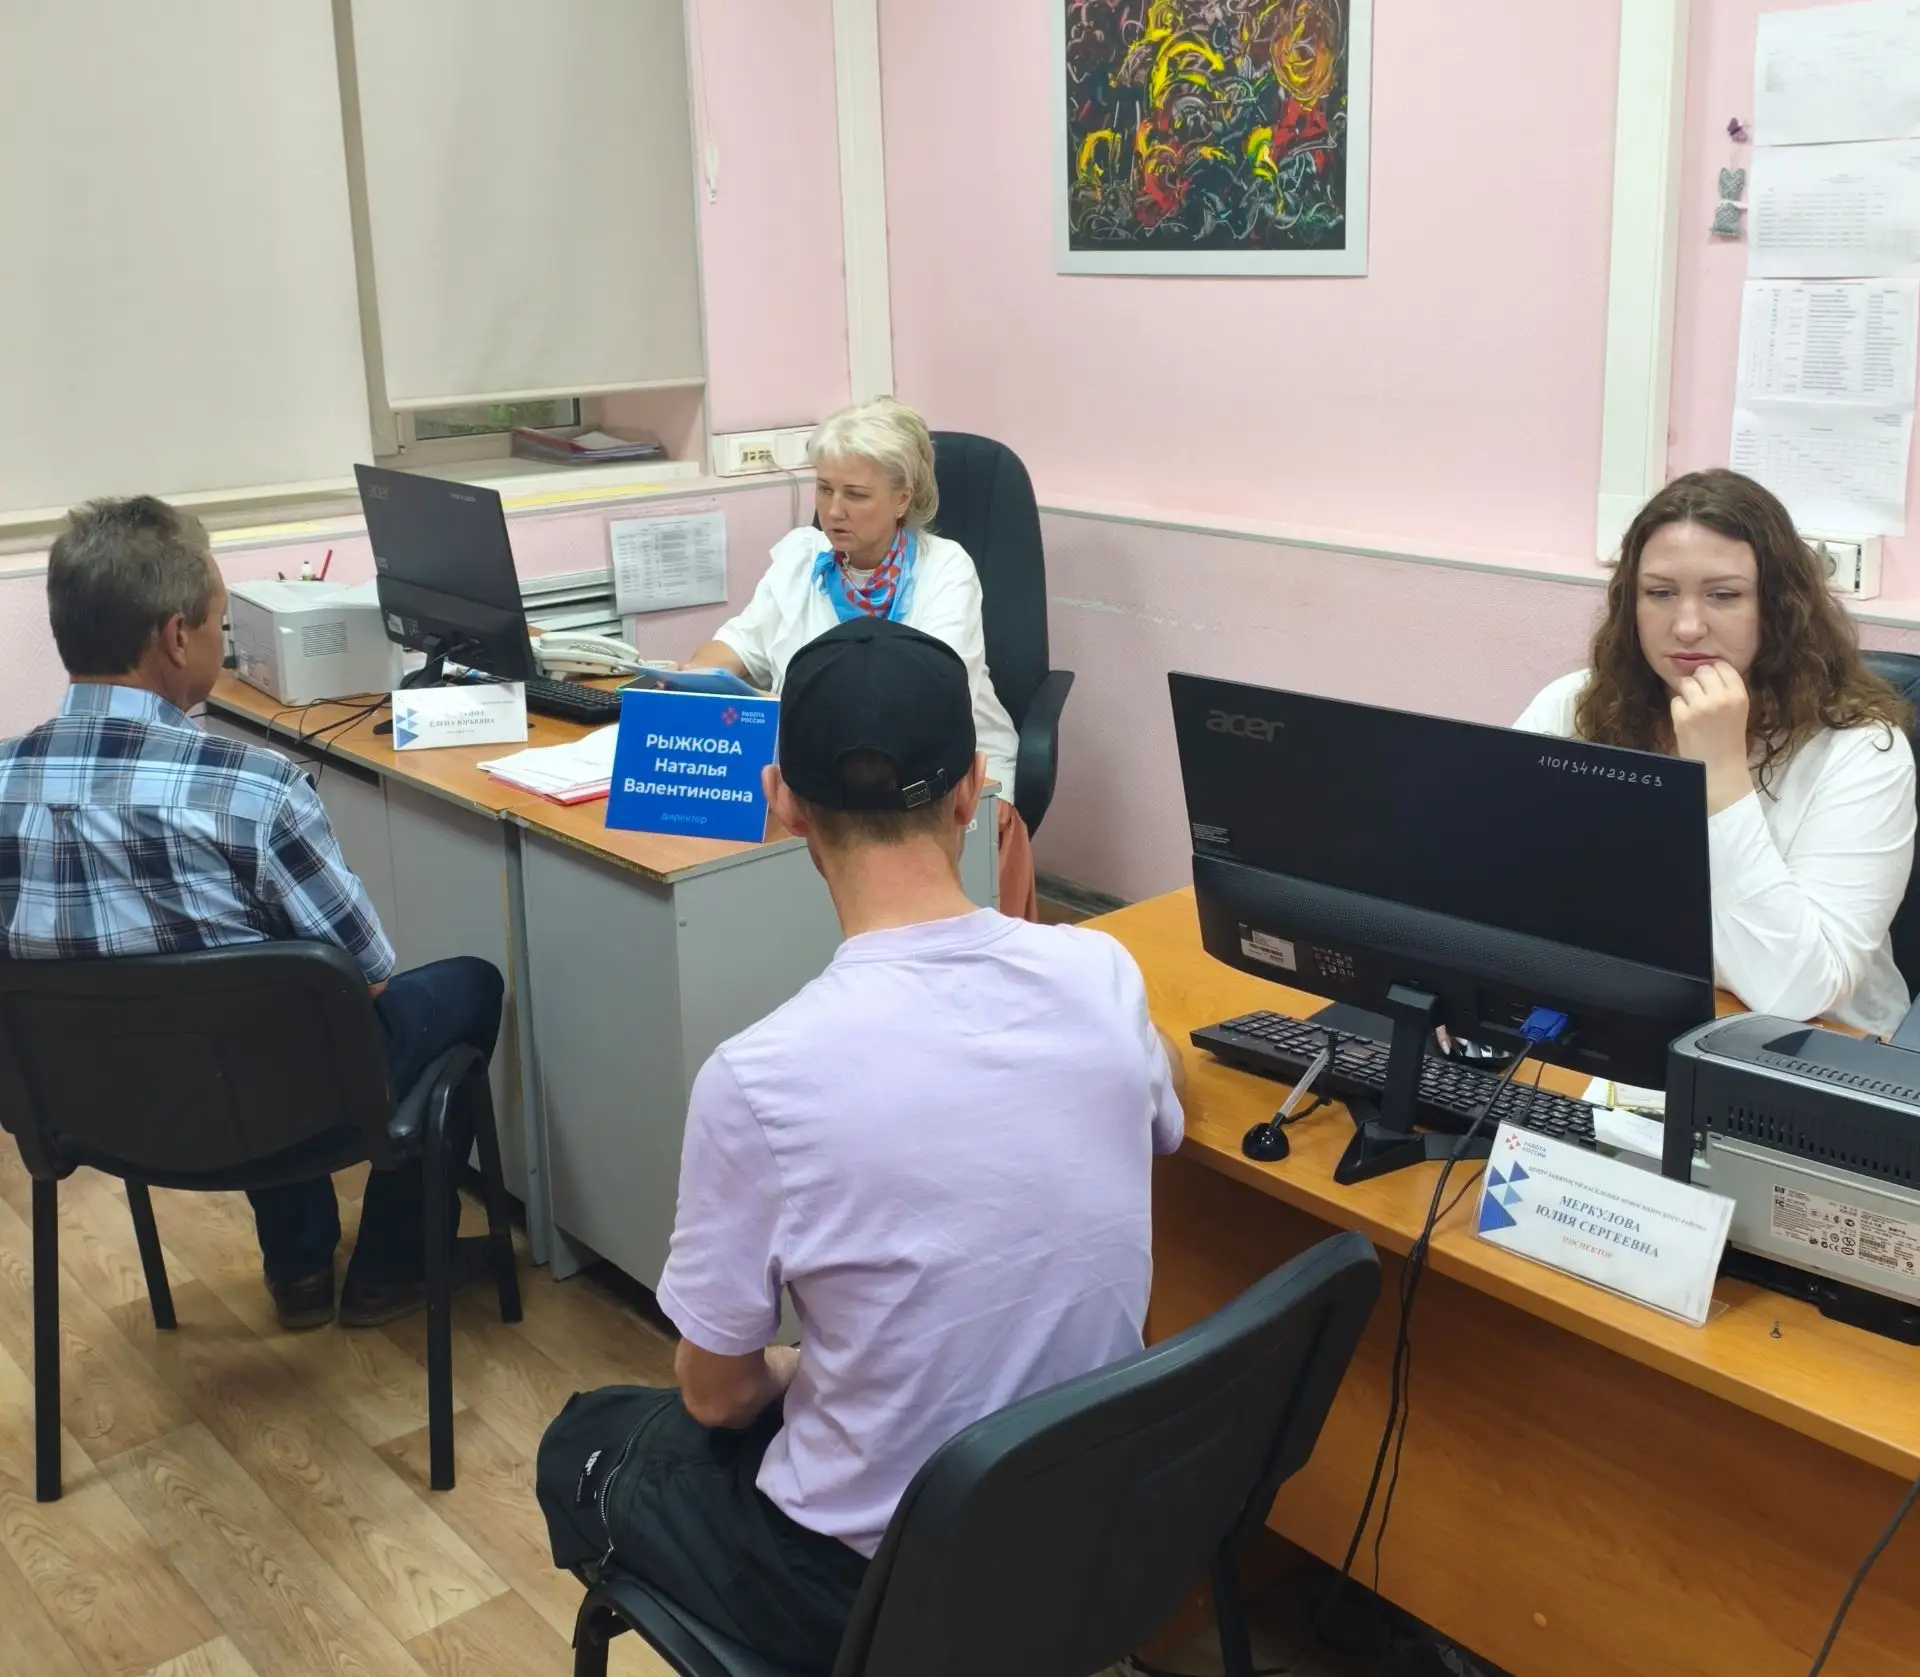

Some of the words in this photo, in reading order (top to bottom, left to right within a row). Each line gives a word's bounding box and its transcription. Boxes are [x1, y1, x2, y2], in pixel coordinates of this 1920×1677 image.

[740, 717, 766, 725] РОССИИ
[741, 710, 765, 718] РАБОТА
[1205, 708, 1285, 743] acer
[645, 733, 743, 756] РЫЖКОВА
[654, 757, 728, 777] Наталья
[623, 777, 753, 803] Валентиновна
[660, 812, 708, 825] директор
[1523, 1140, 1547, 1152] РАБОТА
[1548, 1171, 1583, 1188] ЗАНЯТОСТИ
[1582, 1184, 1621, 1202] НАСЕЛЕНИЯ
[1559, 1195, 1641, 1233] МЕРКУЛОВА
[1535, 1204, 1577, 1228] ЮЛИЯ
[1579, 1219, 1659, 1258] СЕРГЕЕВНА
[1562, 1235, 1614, 1259] ИНСПЕКТОР
